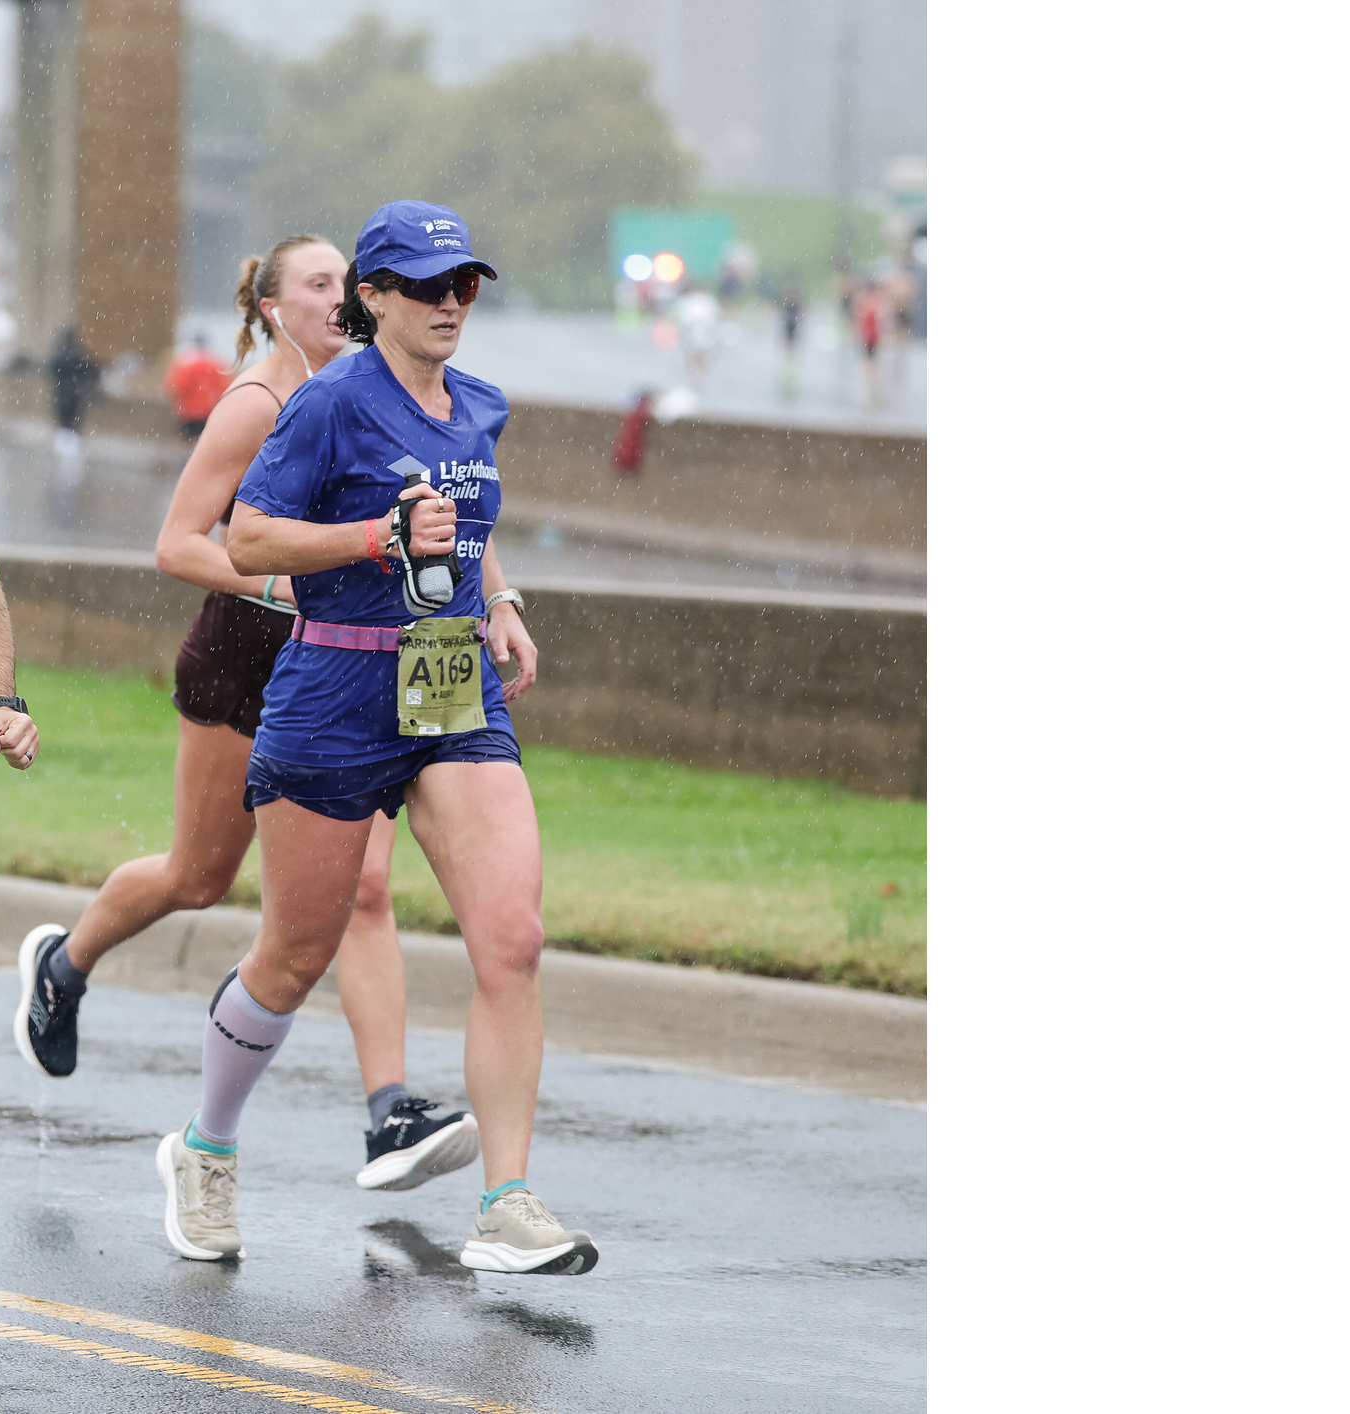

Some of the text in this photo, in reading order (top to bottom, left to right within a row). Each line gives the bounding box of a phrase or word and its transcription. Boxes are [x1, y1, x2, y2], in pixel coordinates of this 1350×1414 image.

[451, 536, 485, 560] eta
[406, 638, 438, 650] ARMY
[406, 652, 474, 687] A169
